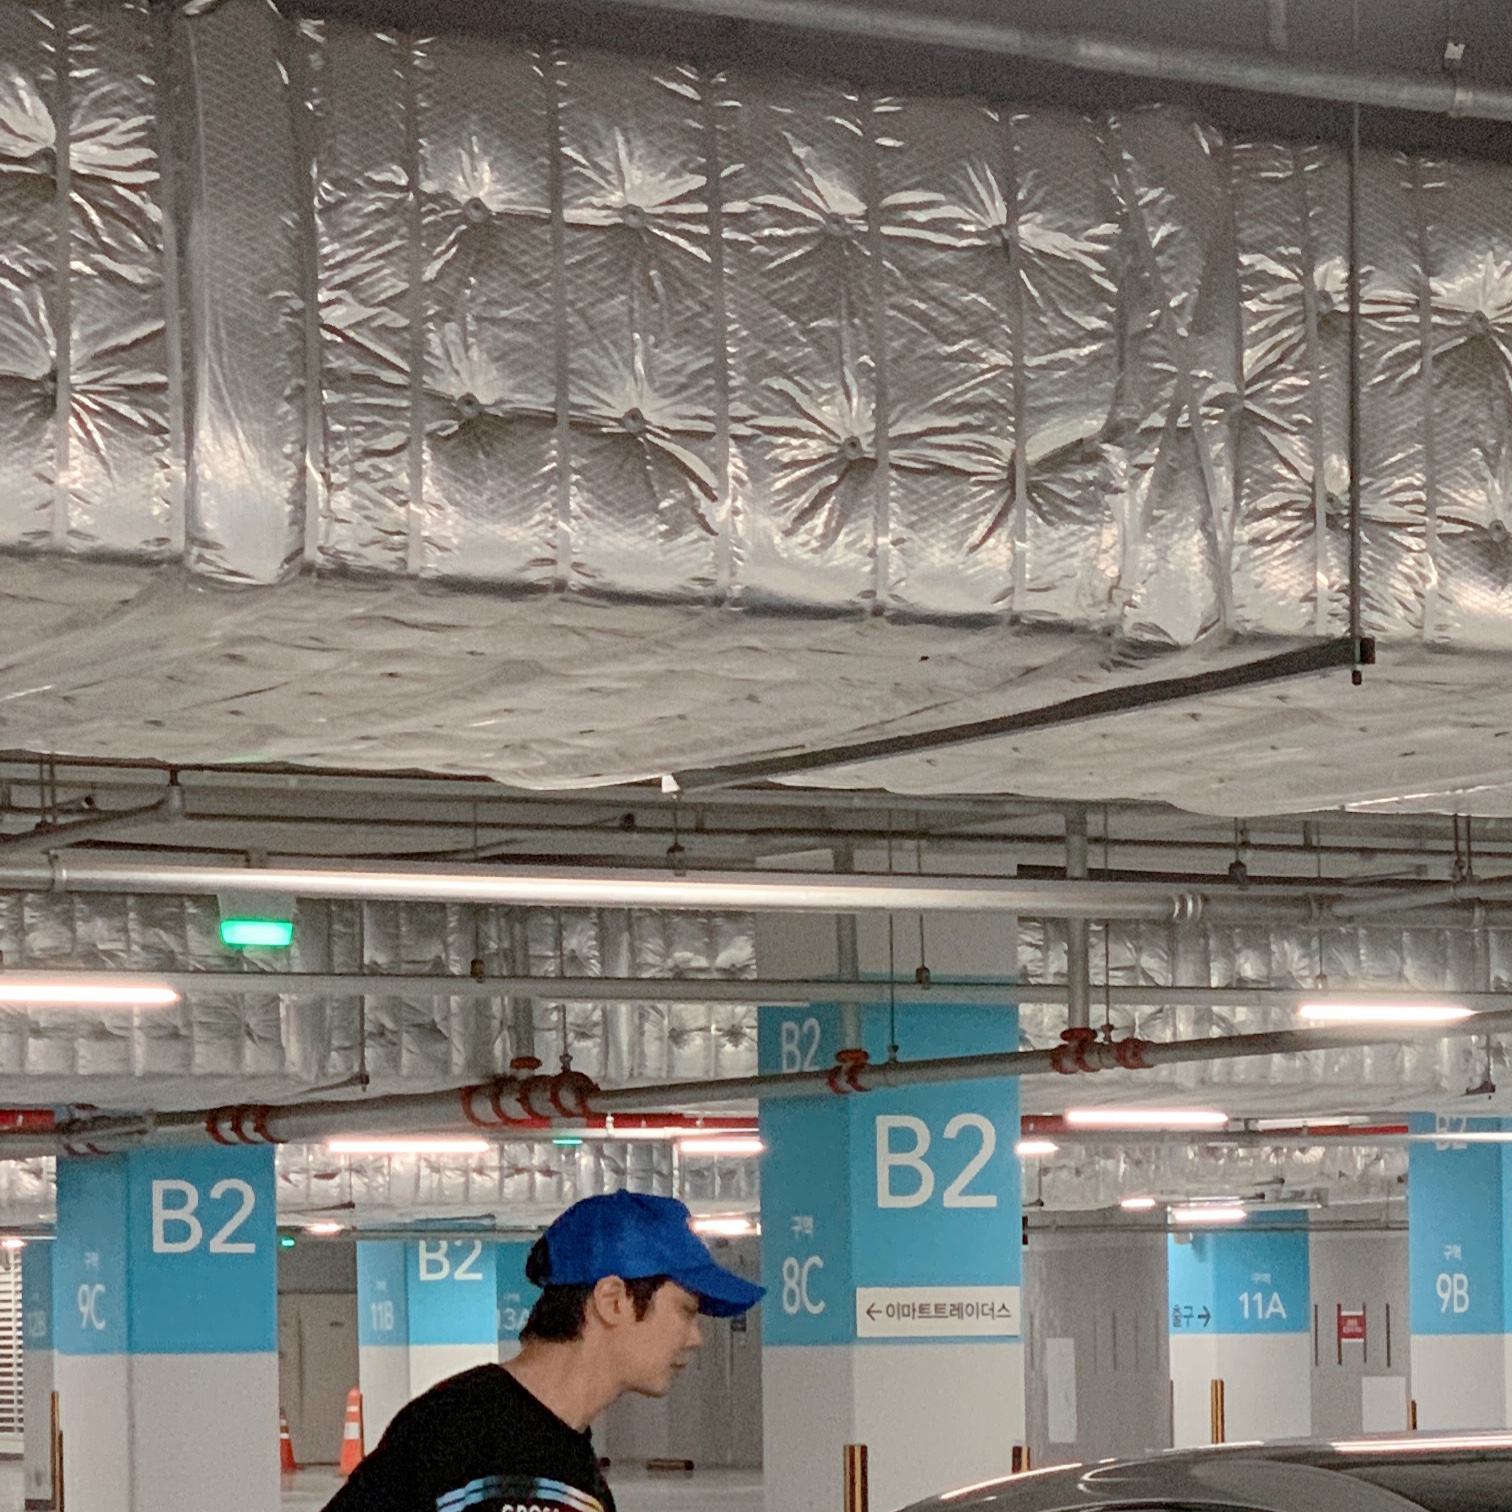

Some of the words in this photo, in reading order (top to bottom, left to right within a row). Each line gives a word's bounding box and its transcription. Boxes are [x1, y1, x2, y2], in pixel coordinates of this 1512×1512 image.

[780, 1017, 821, 1074] B2
[876, 1112, 998, 1209] B2
[152, 1178, 256, 1254] B2
[418, 1240, 483, 1281] B2
[77, 1283, 106, 1331] 9C
[781, 1256, 826, 1315] 8C
[1239, 1291, 1287, 1319] 11A
[1436, 1273, 1469, 1313] 9B
[371, 1302, 394, 1331] 11B
[886, 1302, 1013, 1321] 이마트트레이더스
